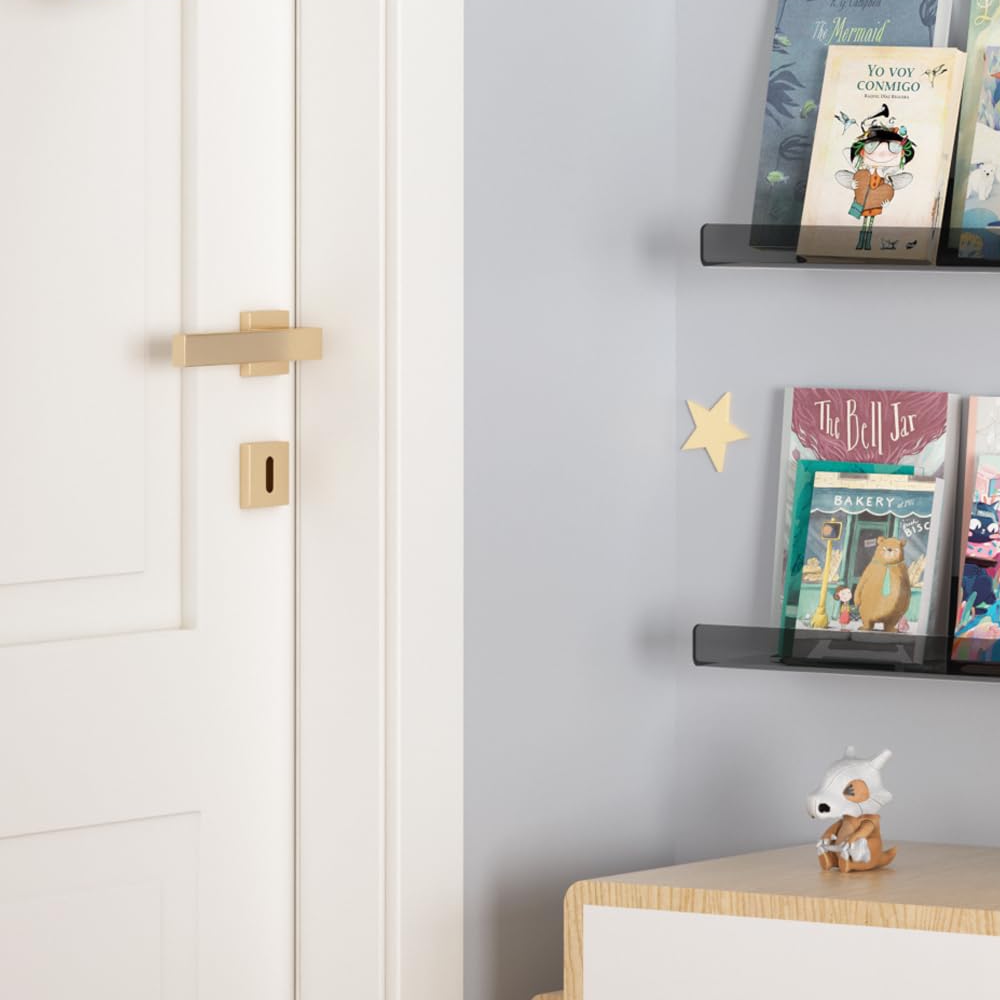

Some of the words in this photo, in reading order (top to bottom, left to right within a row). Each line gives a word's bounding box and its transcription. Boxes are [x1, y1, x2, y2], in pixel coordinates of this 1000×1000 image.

[828, 16, 892, 46] Mermaid
[889, 68, 916, 78] VOY
[857, 81, 921, 92] CONMIGO
[814, 400, 840, 440] The
[846, 399, 883, 456] Bell
[890, 401, 917, 442] Jar
[834, 495, 895, 508] BAKERY
